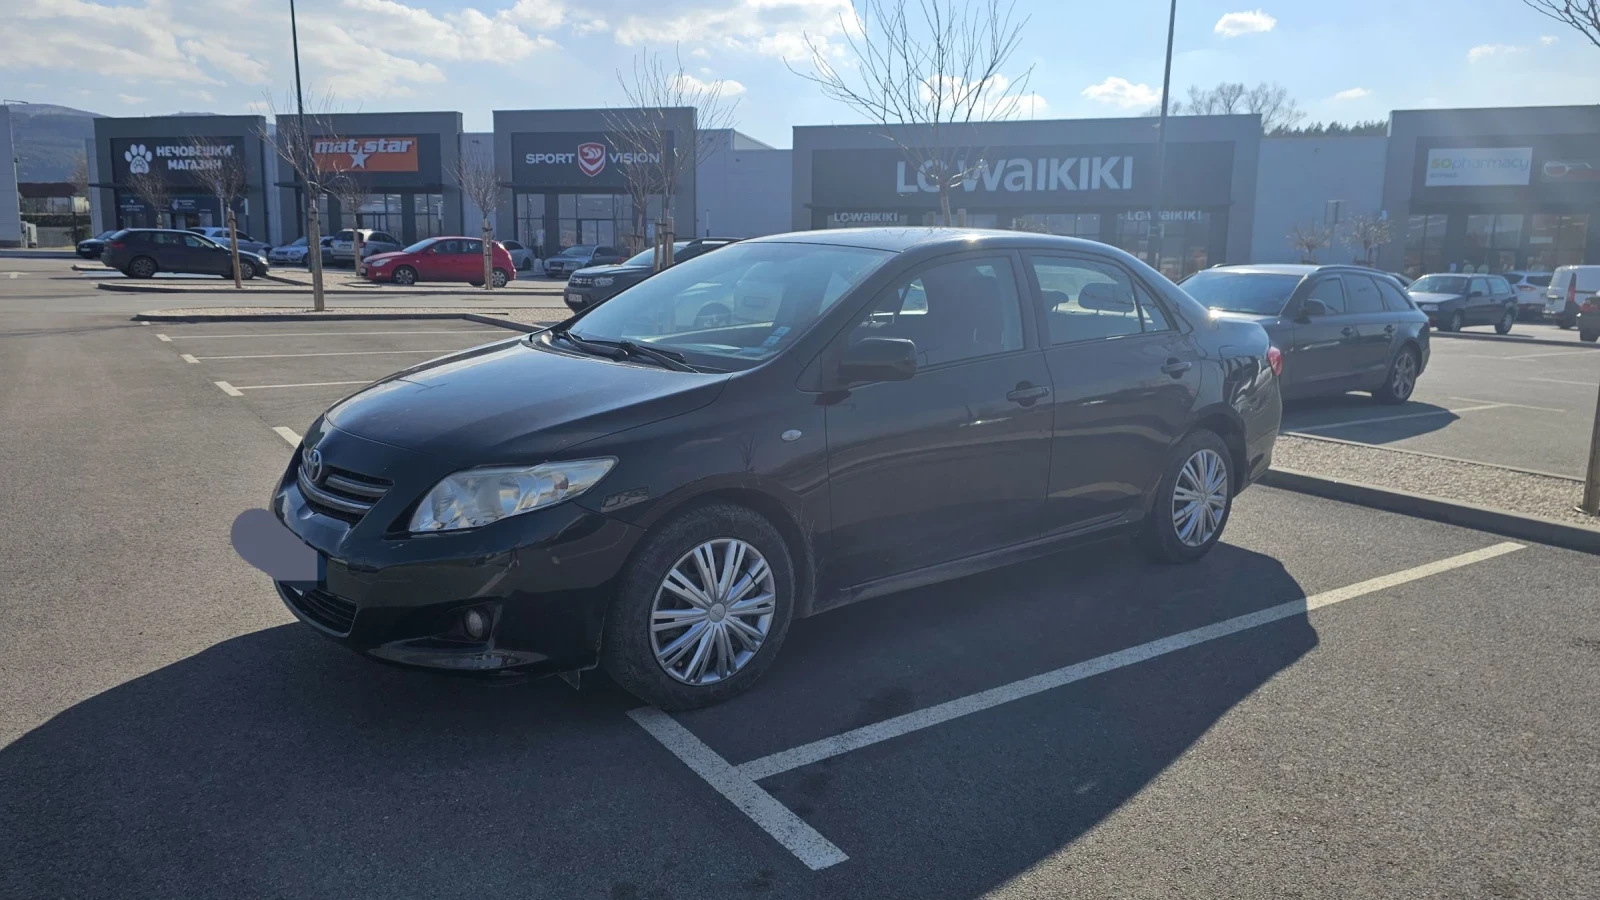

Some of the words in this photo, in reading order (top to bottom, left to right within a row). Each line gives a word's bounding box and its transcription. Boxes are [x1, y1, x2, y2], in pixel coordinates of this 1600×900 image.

[156, 145, 232, 157] НЕЧОВЕШКИ
[315, 138, 358, 153] mat
[364, 138, 413, 153] star
[168, 159, 222, 170] МАГАЗИН
[526, 153, 575, 164] SPORT
[609, 153, 660, 164] VISION
[1431, 156, 1528, 171] sopharmacy
